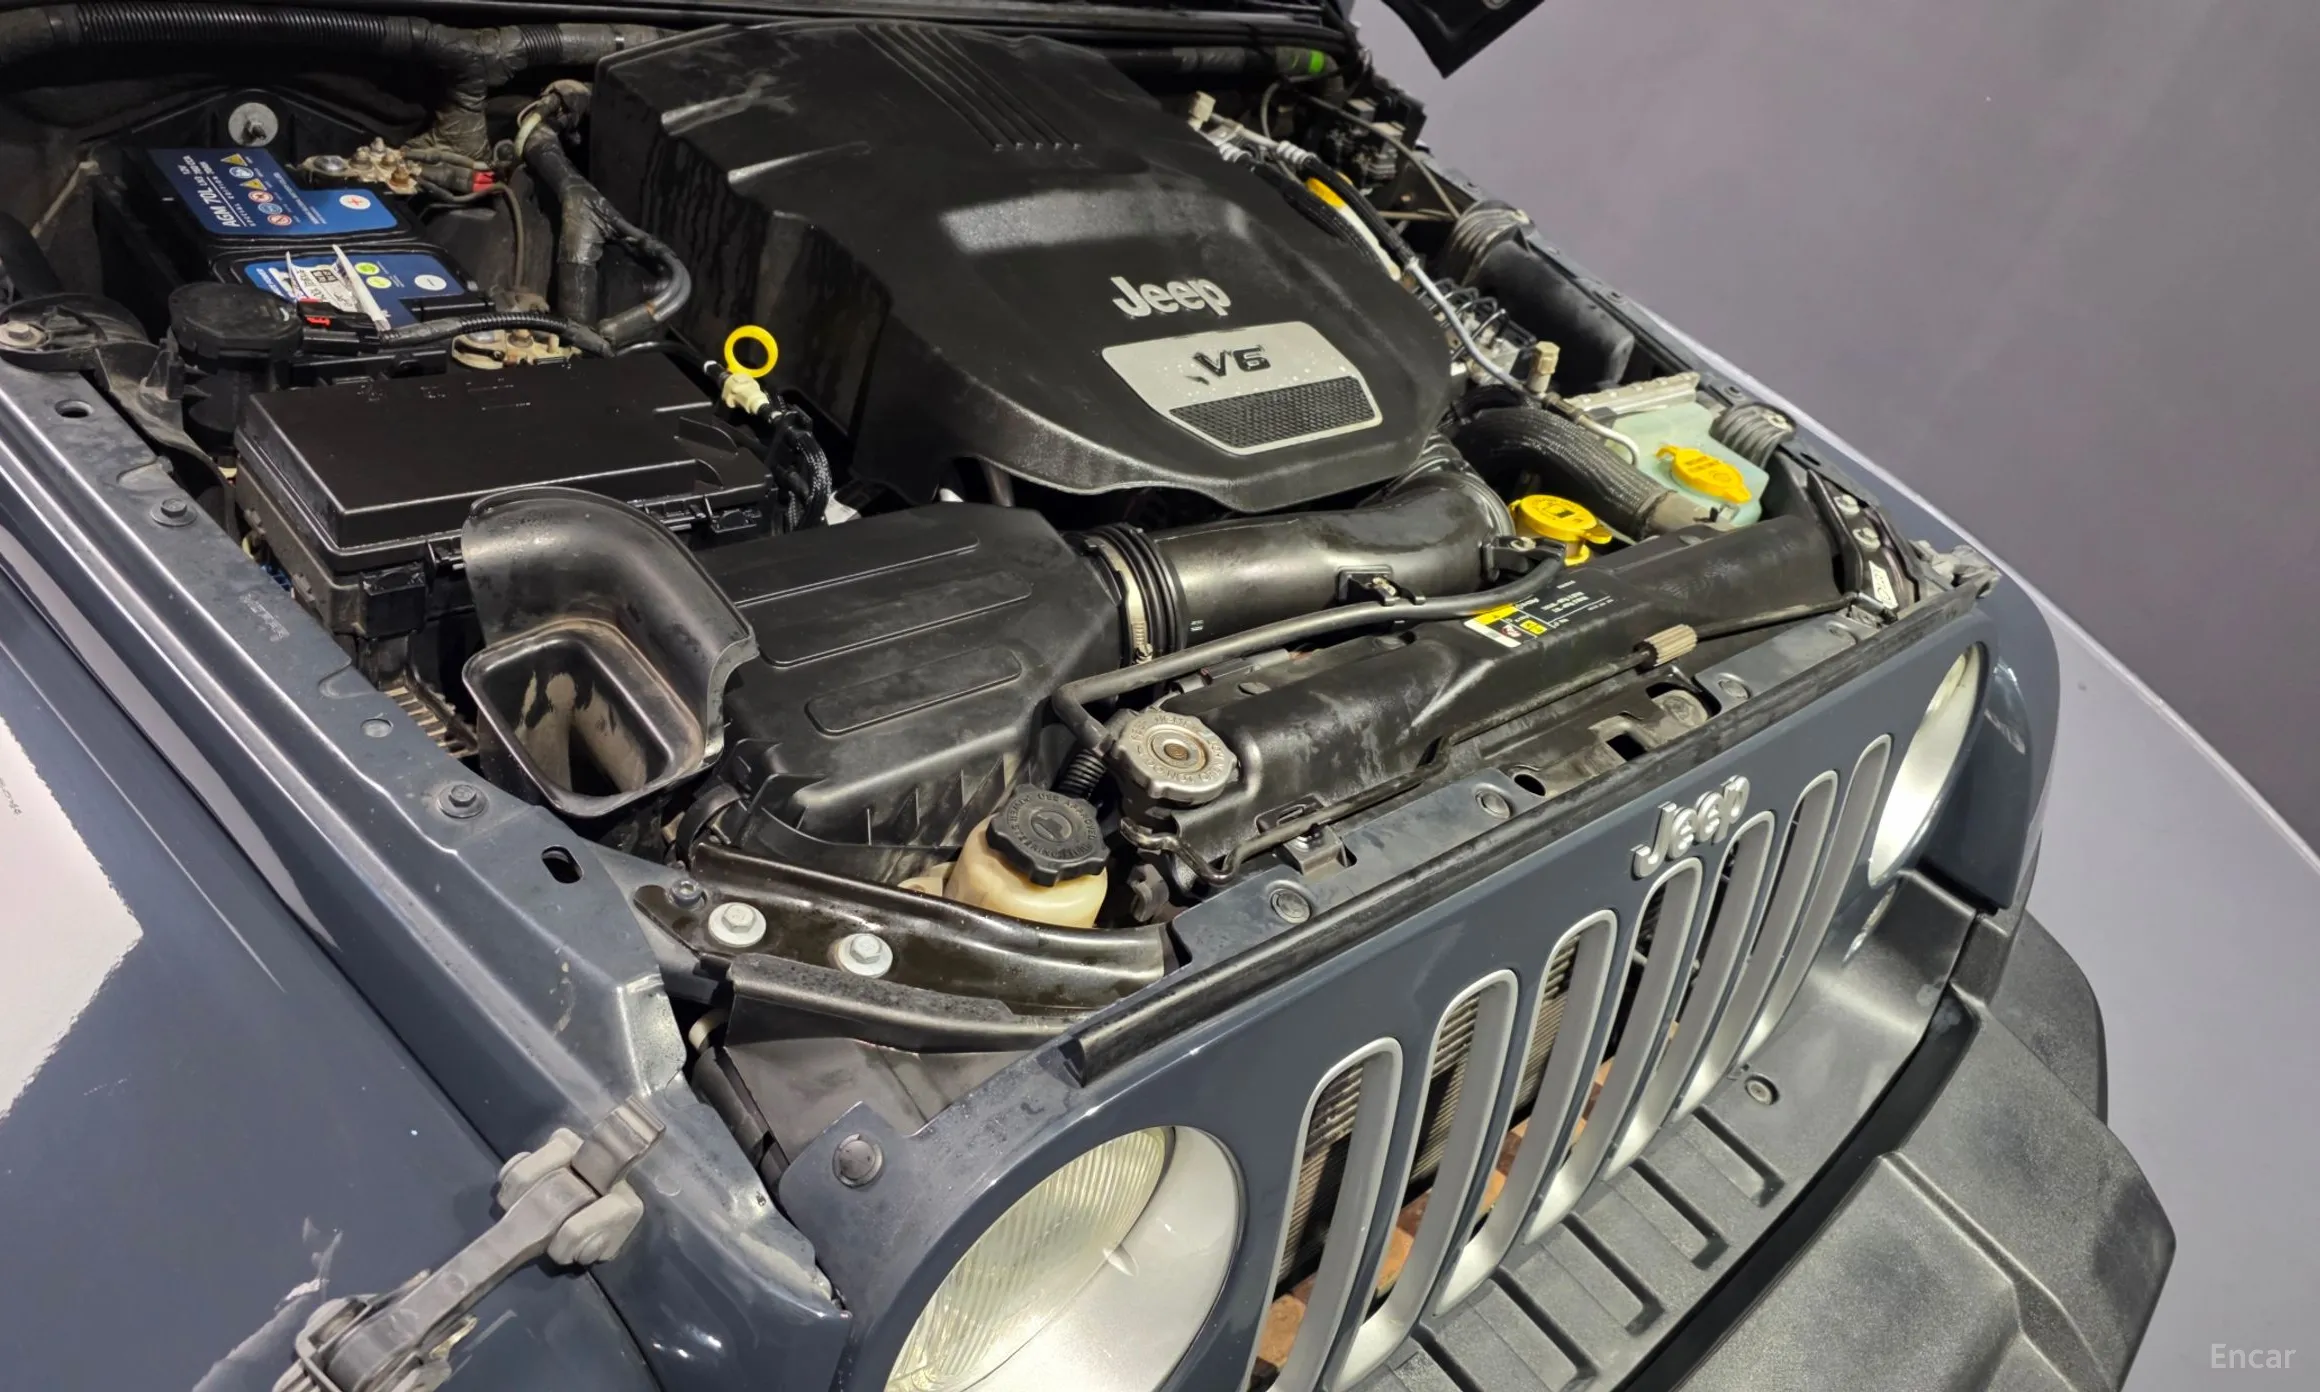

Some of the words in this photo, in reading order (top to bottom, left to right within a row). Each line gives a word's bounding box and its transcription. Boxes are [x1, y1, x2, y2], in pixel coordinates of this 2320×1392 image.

[197, 187, 223, 205] 70L
[210, 205, 241, 228] AGM
[1110, 276, 1231, 318] Jeep
[1192, 345, 1272, 378] V6
[1630, 775, 1750, 880] Jeep
